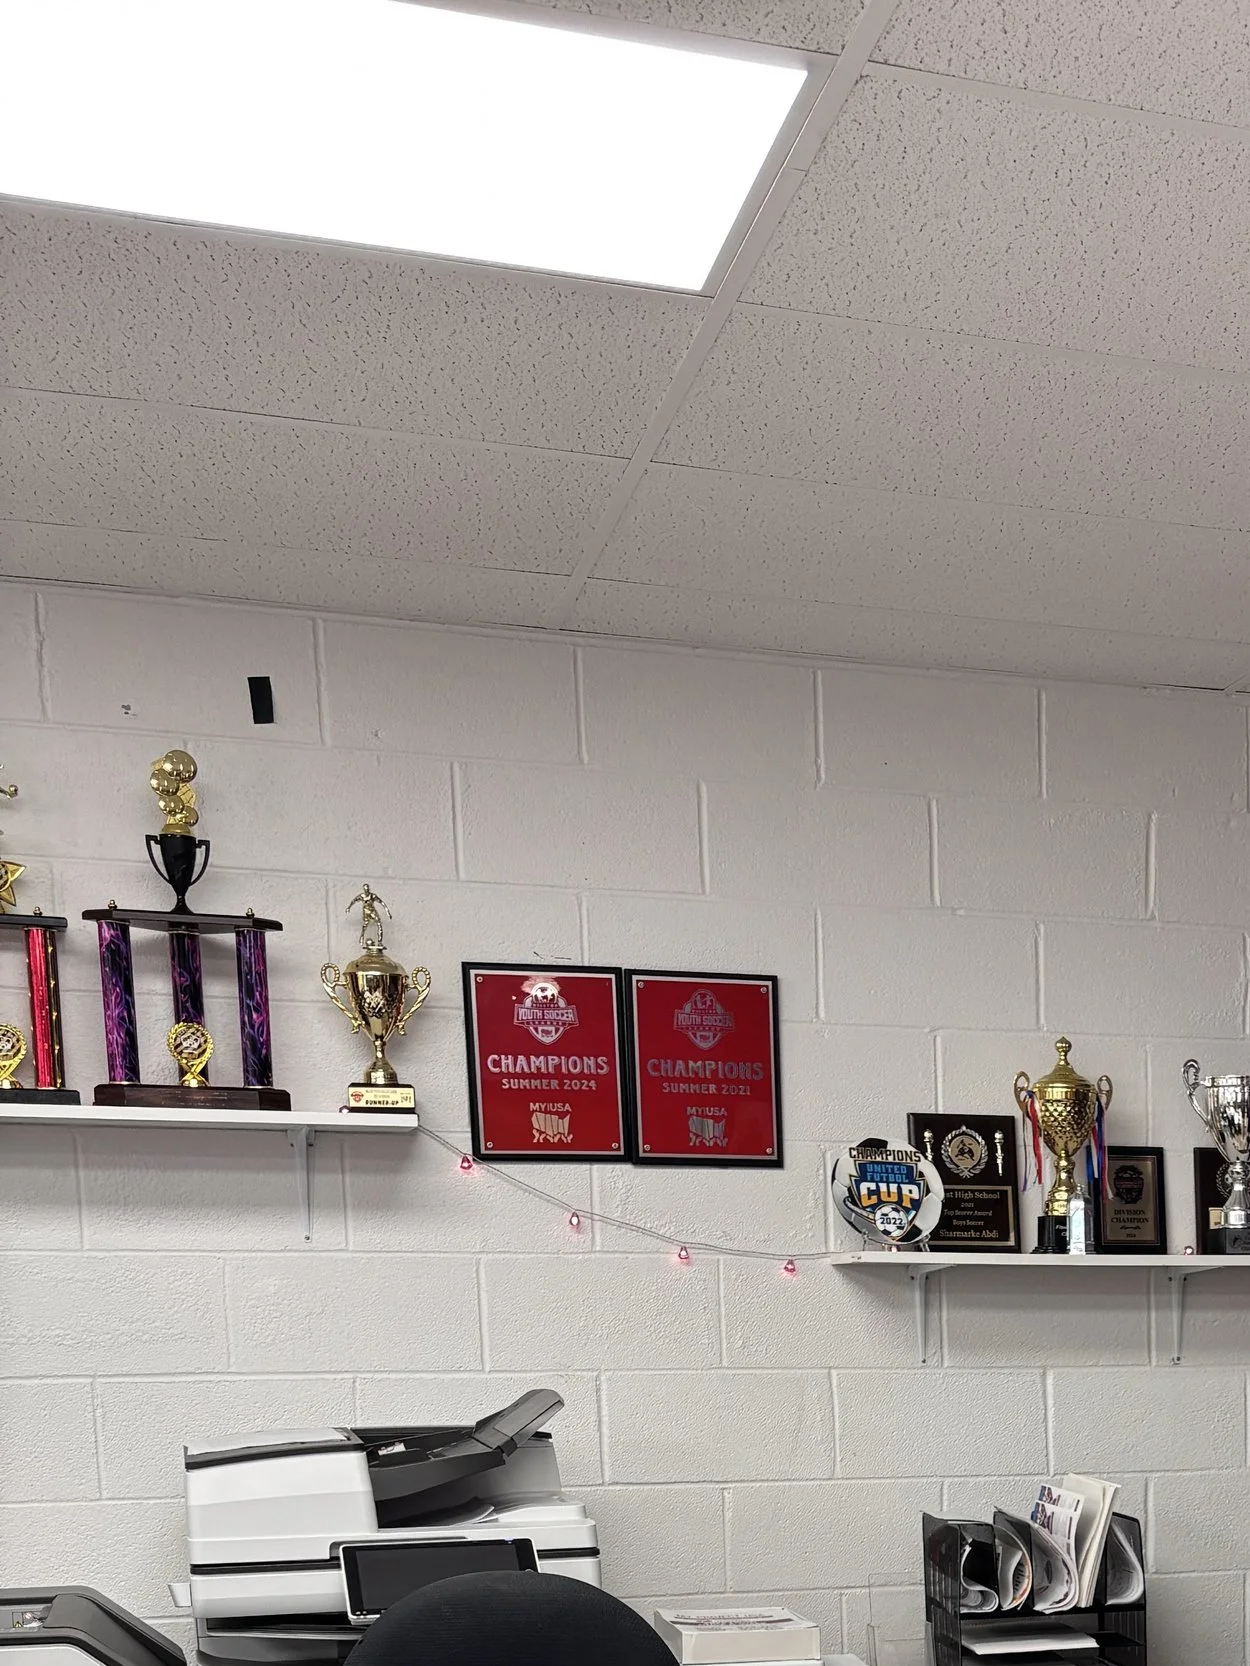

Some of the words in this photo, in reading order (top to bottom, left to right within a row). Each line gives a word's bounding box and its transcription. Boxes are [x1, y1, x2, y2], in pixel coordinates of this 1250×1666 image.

[518, 1008, 542, 1021] YOUTH
[544, 1009, 574, 1021] SOCCER
[678, 1013, 701, 1025] YOUTH
[487, 1054, 609, 1074] CHAMPIONS
[647, 1058, 765, 1081] CHAMPIONS
[502, 1079, 560, 1090] SUMMER
[563, 1080, 597, 1090] 2024
[662, 1082, 717, 1094] SUMMER
[722, 1084, 751, 1095] 2021
[849, 1147, 921, 1163] CHAMPIONS
[866, 1163, 907, 1174] UNITED
[867, 1173, 909, 1183] FUTBOL
[859, 1182, 920, 1208] CUP
[955, 1191, 973, 1200] High
[880, 1216, 904, 1225] 2022
[981, 1230, 998, 1238] Abdi
